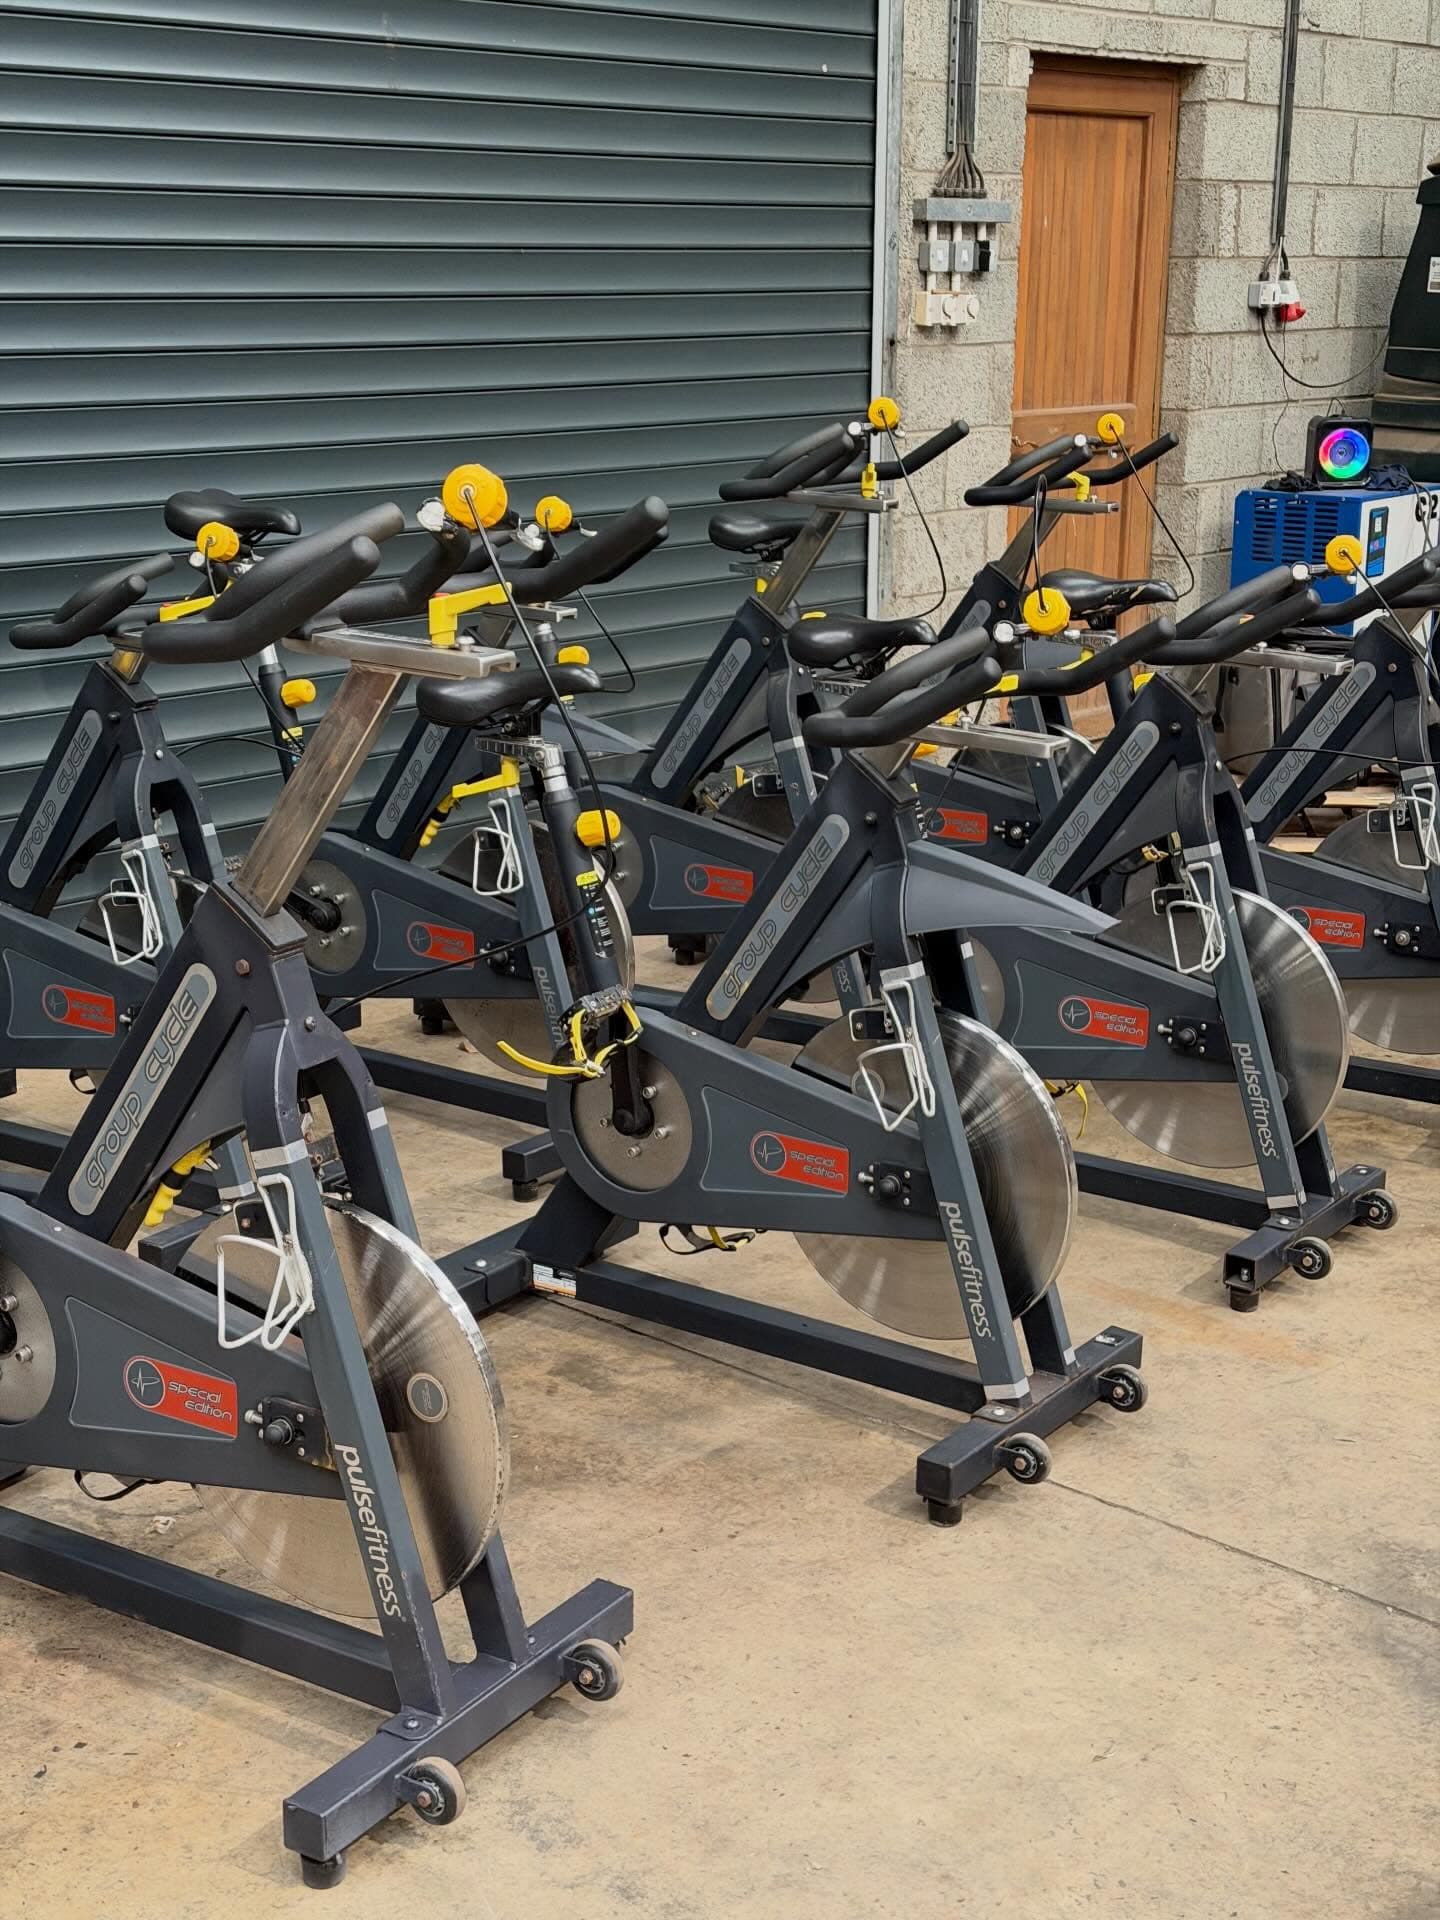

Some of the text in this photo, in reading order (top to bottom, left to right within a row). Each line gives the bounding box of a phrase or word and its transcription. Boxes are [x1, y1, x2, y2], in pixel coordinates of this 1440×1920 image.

[663, 653, 740, 773] group cycle
[1260, 679, 1361, 806] group cycle
[20, 727, 92, 870] group cycle
[386, 759, 423, 824] group
[1037, 738, 1144, 880] group cycle
[723, 919, 777, 1000] group
[780, 835, 833, 912] cycle
[1094, 1011, 1138, 1025] special
[1106, 1023, 1145, 1037] edition
[86, 990, 199, 1189] group cycle
[1231, 1042, 1277, 1157] pulsefitness
[790, 1151, 836, 1167] special
[803, 1164, 845, 1182] edition
[938, 1201, 992, 1338] pulsefitness
[168, 1381, 222, 1403] special
[184, 1400, 233, 1422] edition
[334, 1443, 401, 1618] pulsefitness
